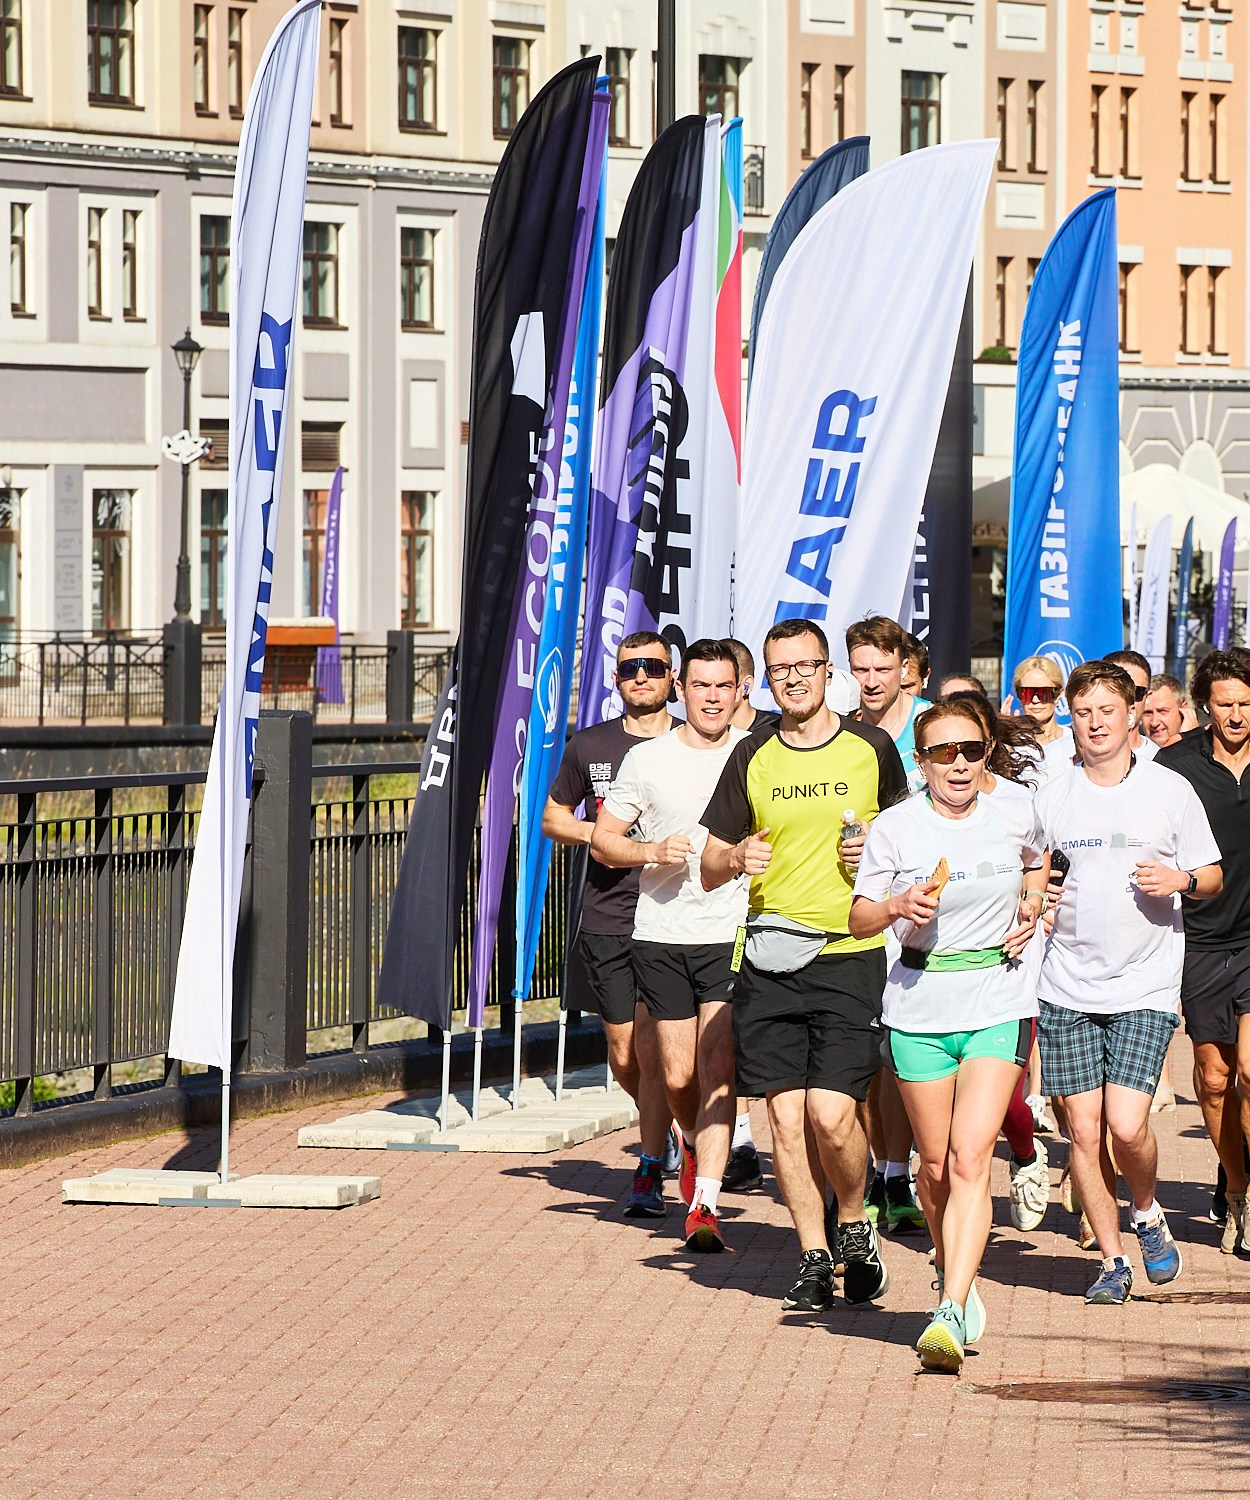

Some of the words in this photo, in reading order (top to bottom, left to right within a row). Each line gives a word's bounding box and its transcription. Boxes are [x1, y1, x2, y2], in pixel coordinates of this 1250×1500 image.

[588, 762, 612, 772] ВЭБ
[772, 782, 830, 801] PUNKT
[834, 782, 848, 796] e
[1068, 838, 1103, 849] MAER
